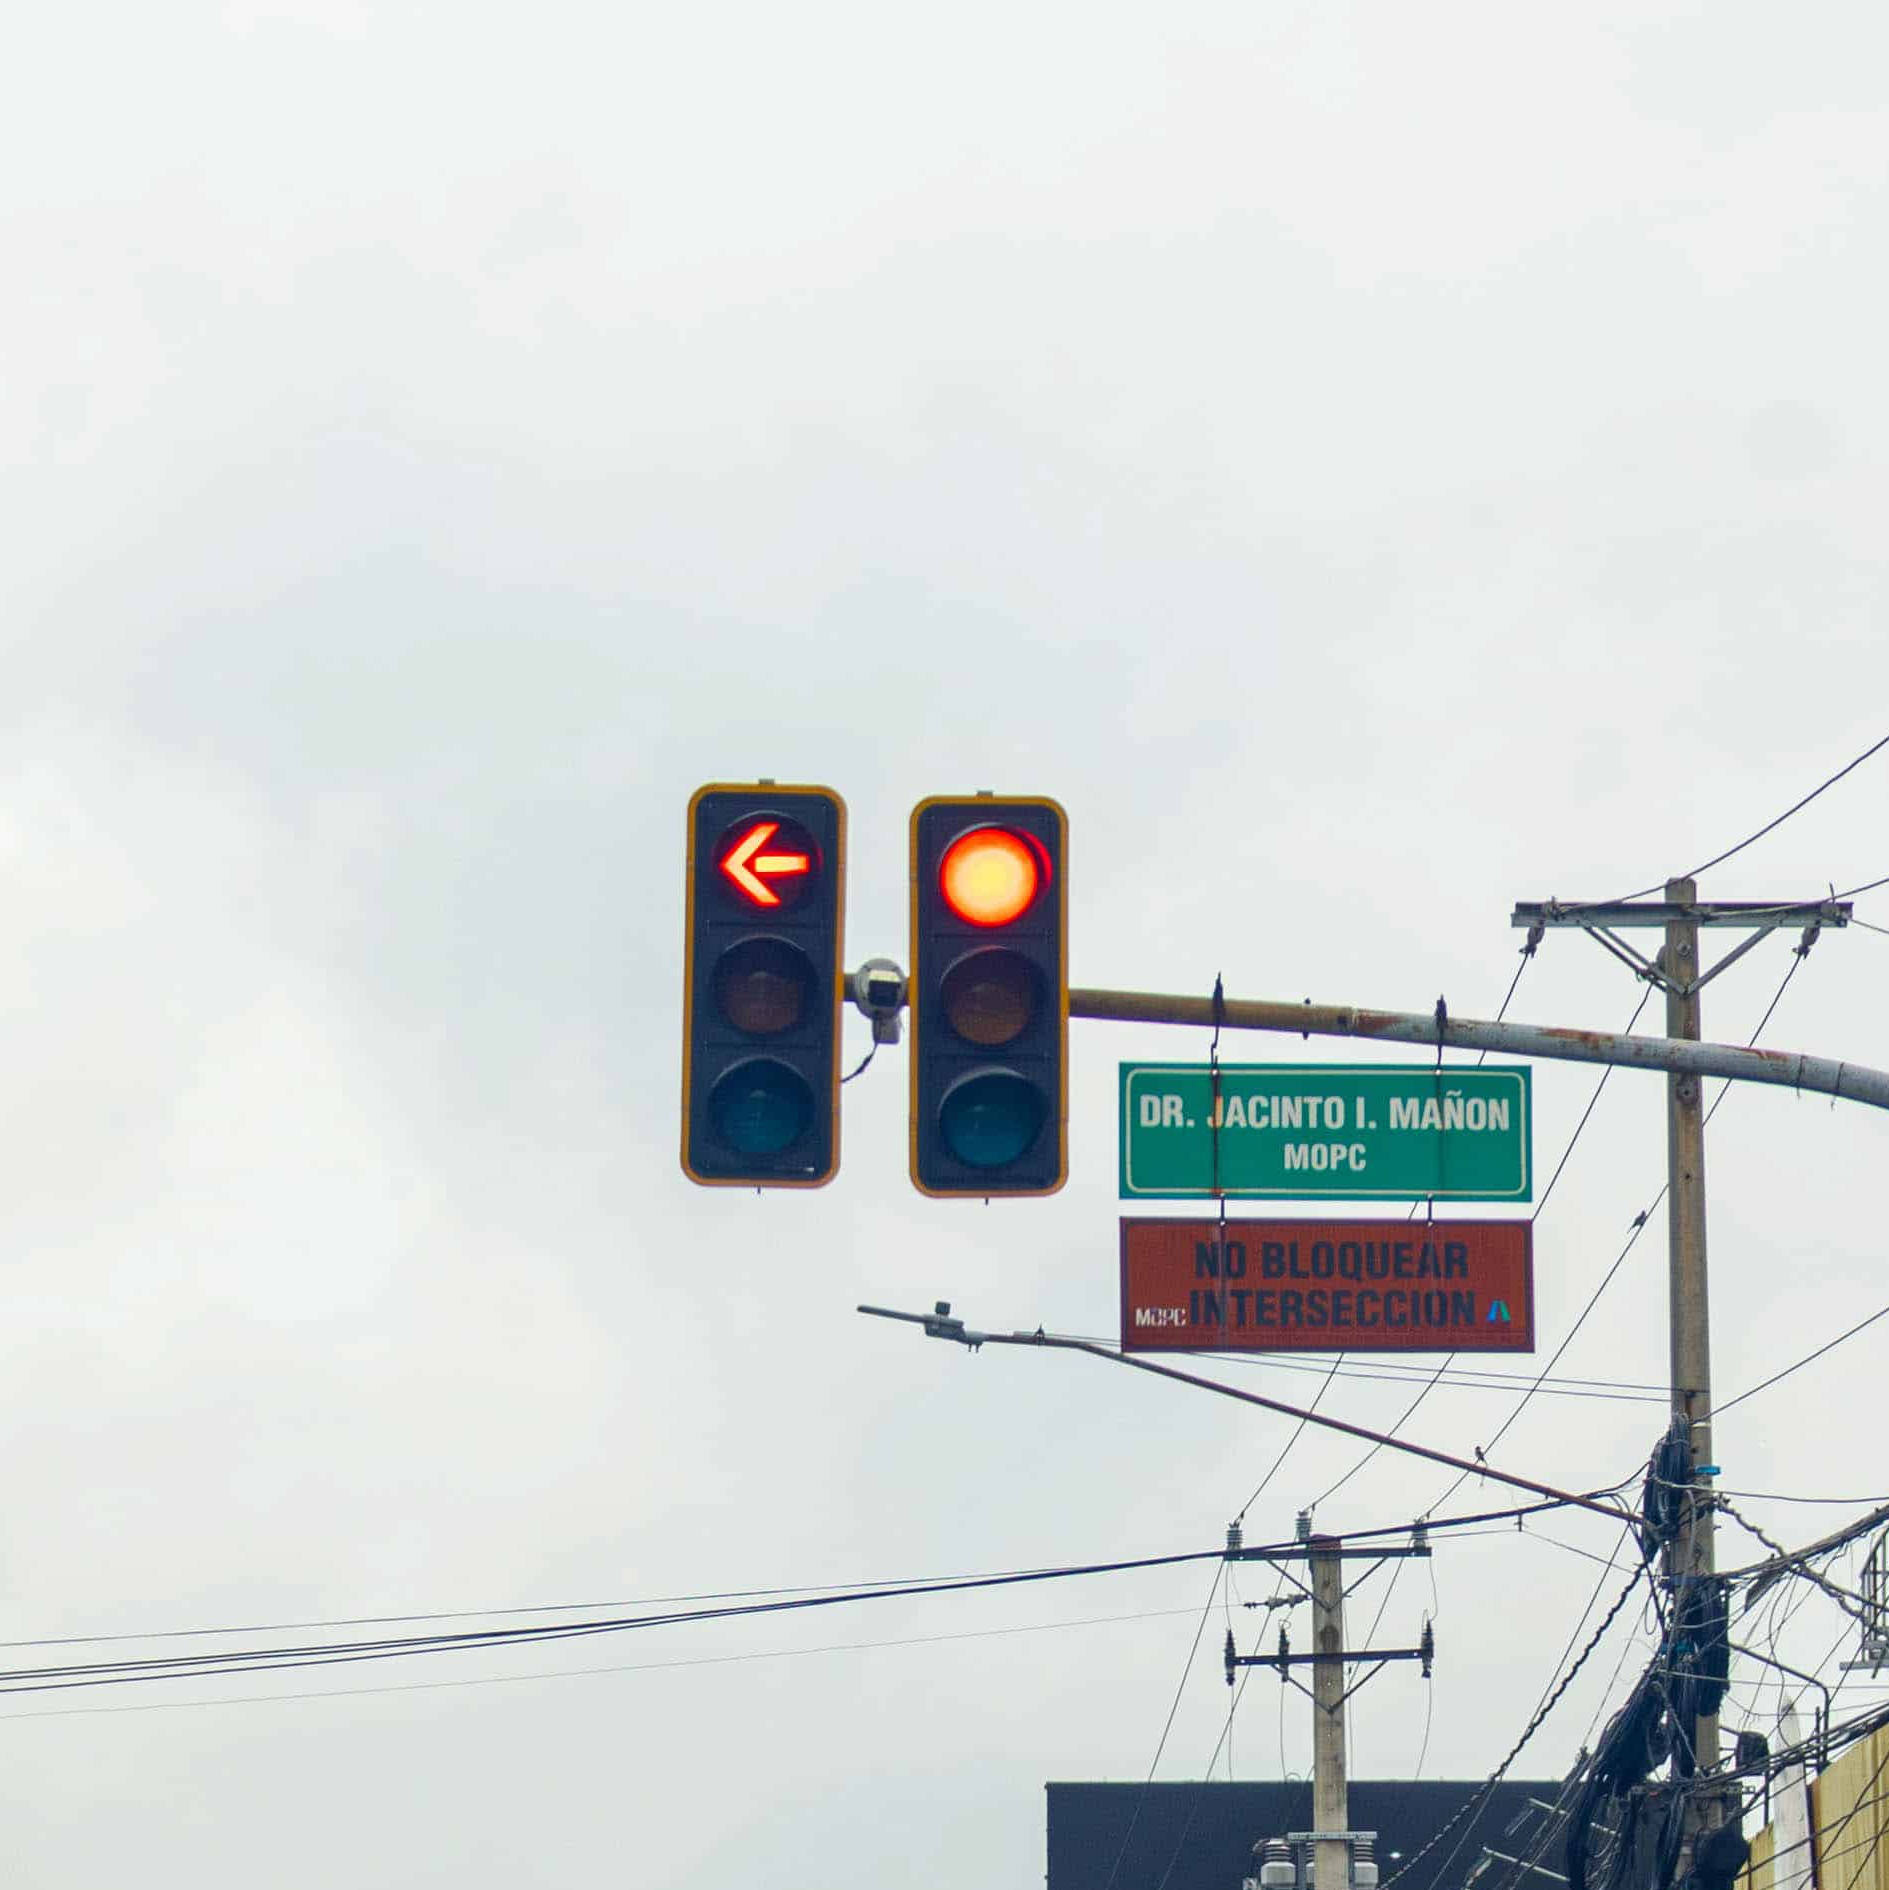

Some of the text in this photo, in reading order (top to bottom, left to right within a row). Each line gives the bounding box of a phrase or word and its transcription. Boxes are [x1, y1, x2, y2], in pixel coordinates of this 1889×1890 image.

[1140, 1089, 1510, 1131] DR. JACINTO I. MAÑON
[1284, 1143, 1367, 1171] MOPC
[1194, 1241, 1469, 1283] NO BLOQUEAR
[1135, 1289, 1476, 1328] MOPC INTERSECCION
